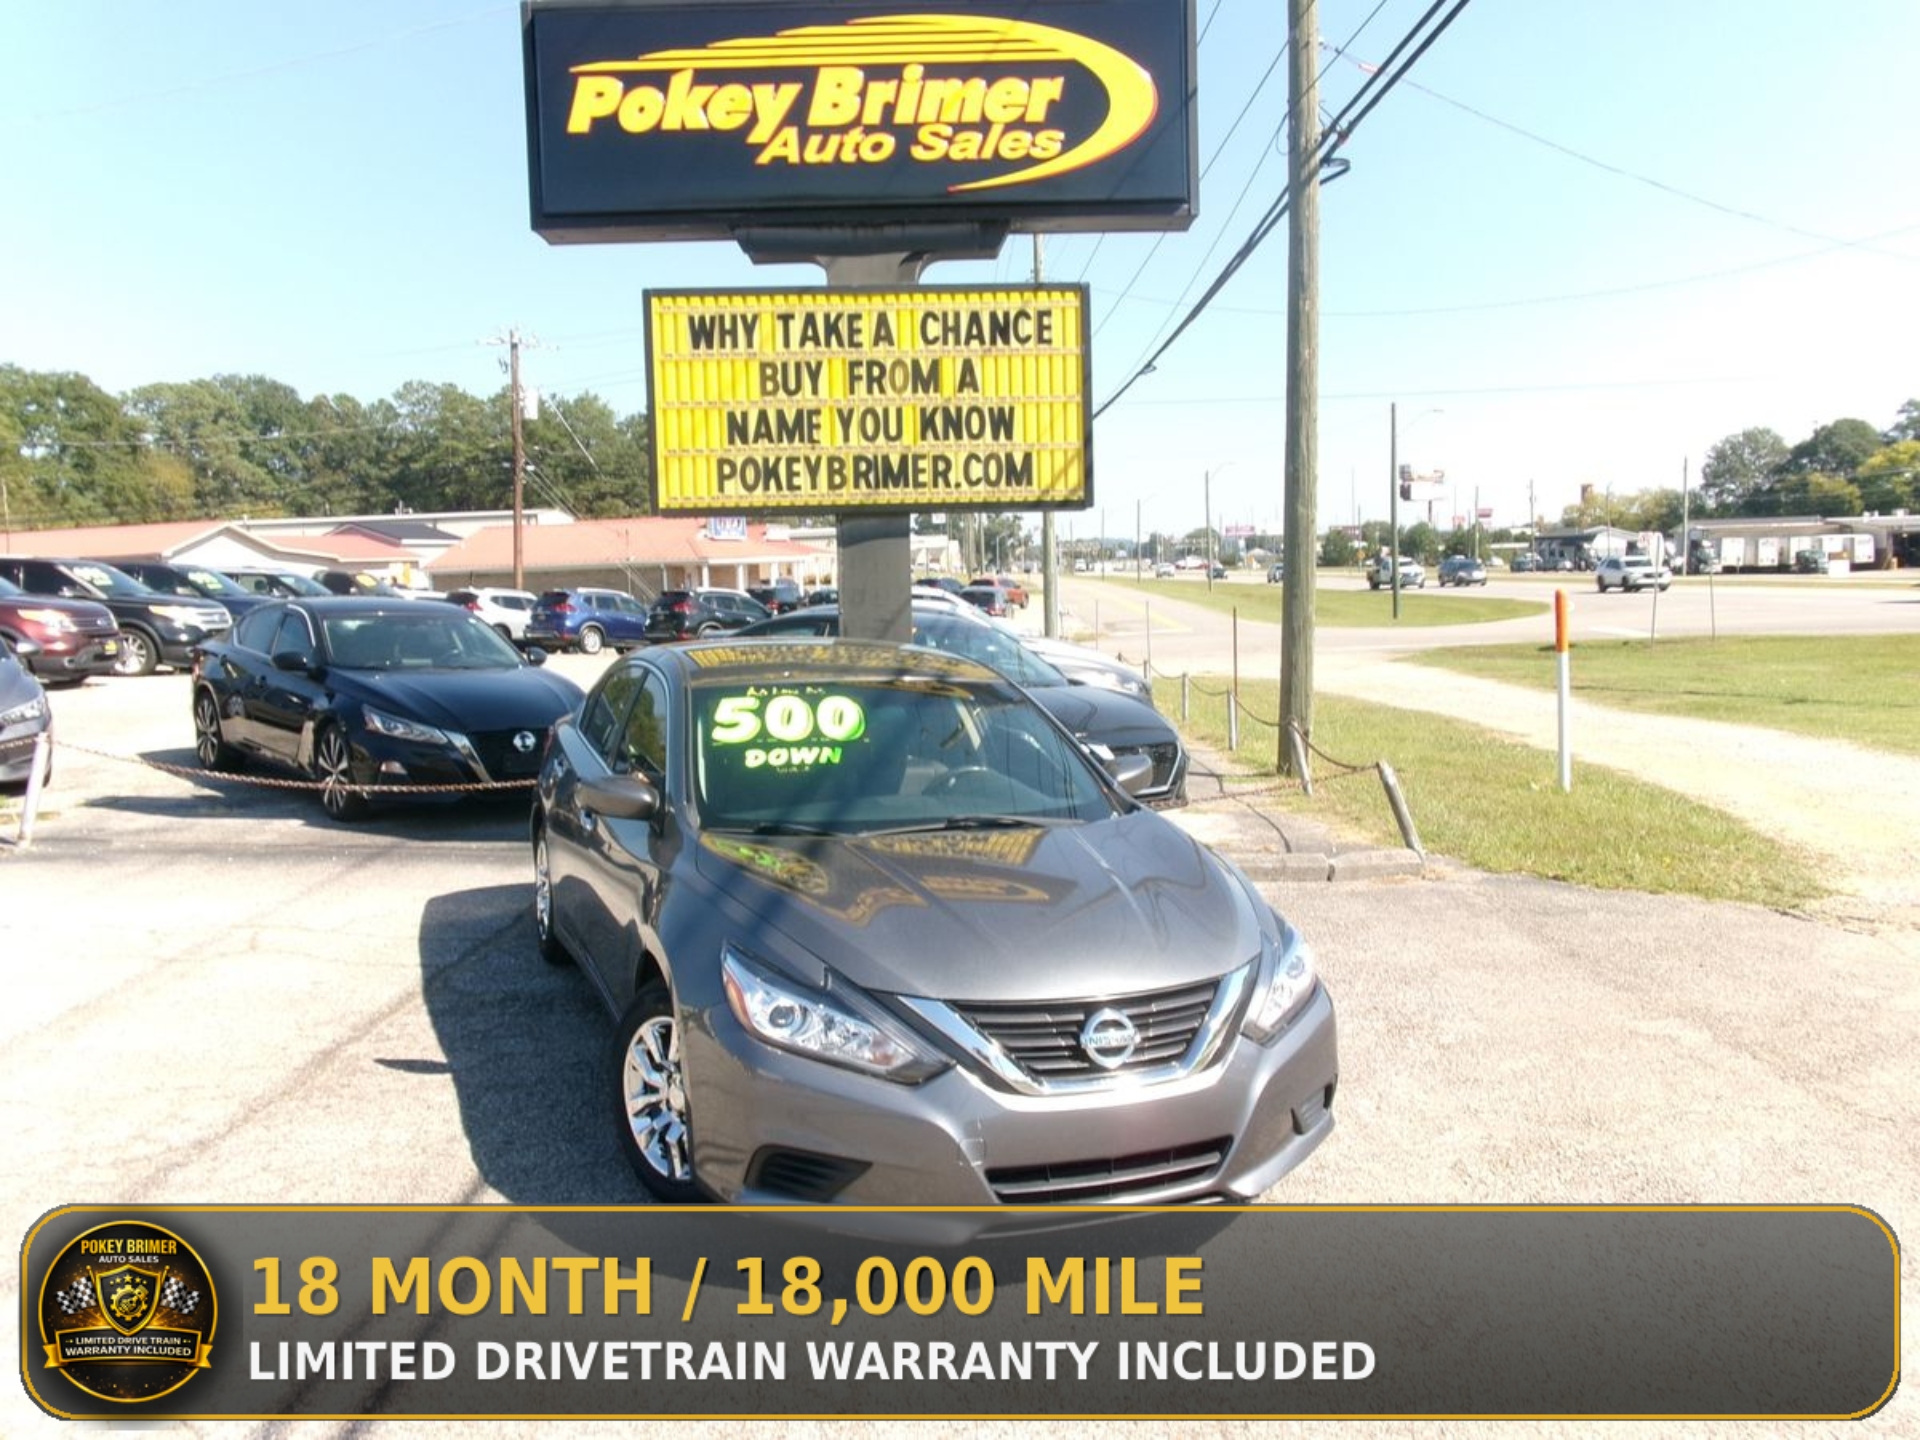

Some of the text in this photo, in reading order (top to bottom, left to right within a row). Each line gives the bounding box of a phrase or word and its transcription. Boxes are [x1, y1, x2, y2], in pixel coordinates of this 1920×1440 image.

[566, 63, 1064, 144] Pokey Brimer
[755, 122, 1065, 164] Auto Sales
[688, 309, 1053, 350] WHY TAKE A CHANCE
[760, 358, 979, 397] BUY FROM A
[727, 406, 1015, 446] NAME YOU KNOW
[716, 452, 1034, 493] POKEYBRIMER.COM
[711, 695, 866, 744] 500
[745, 747, 843, 769] DOWN
